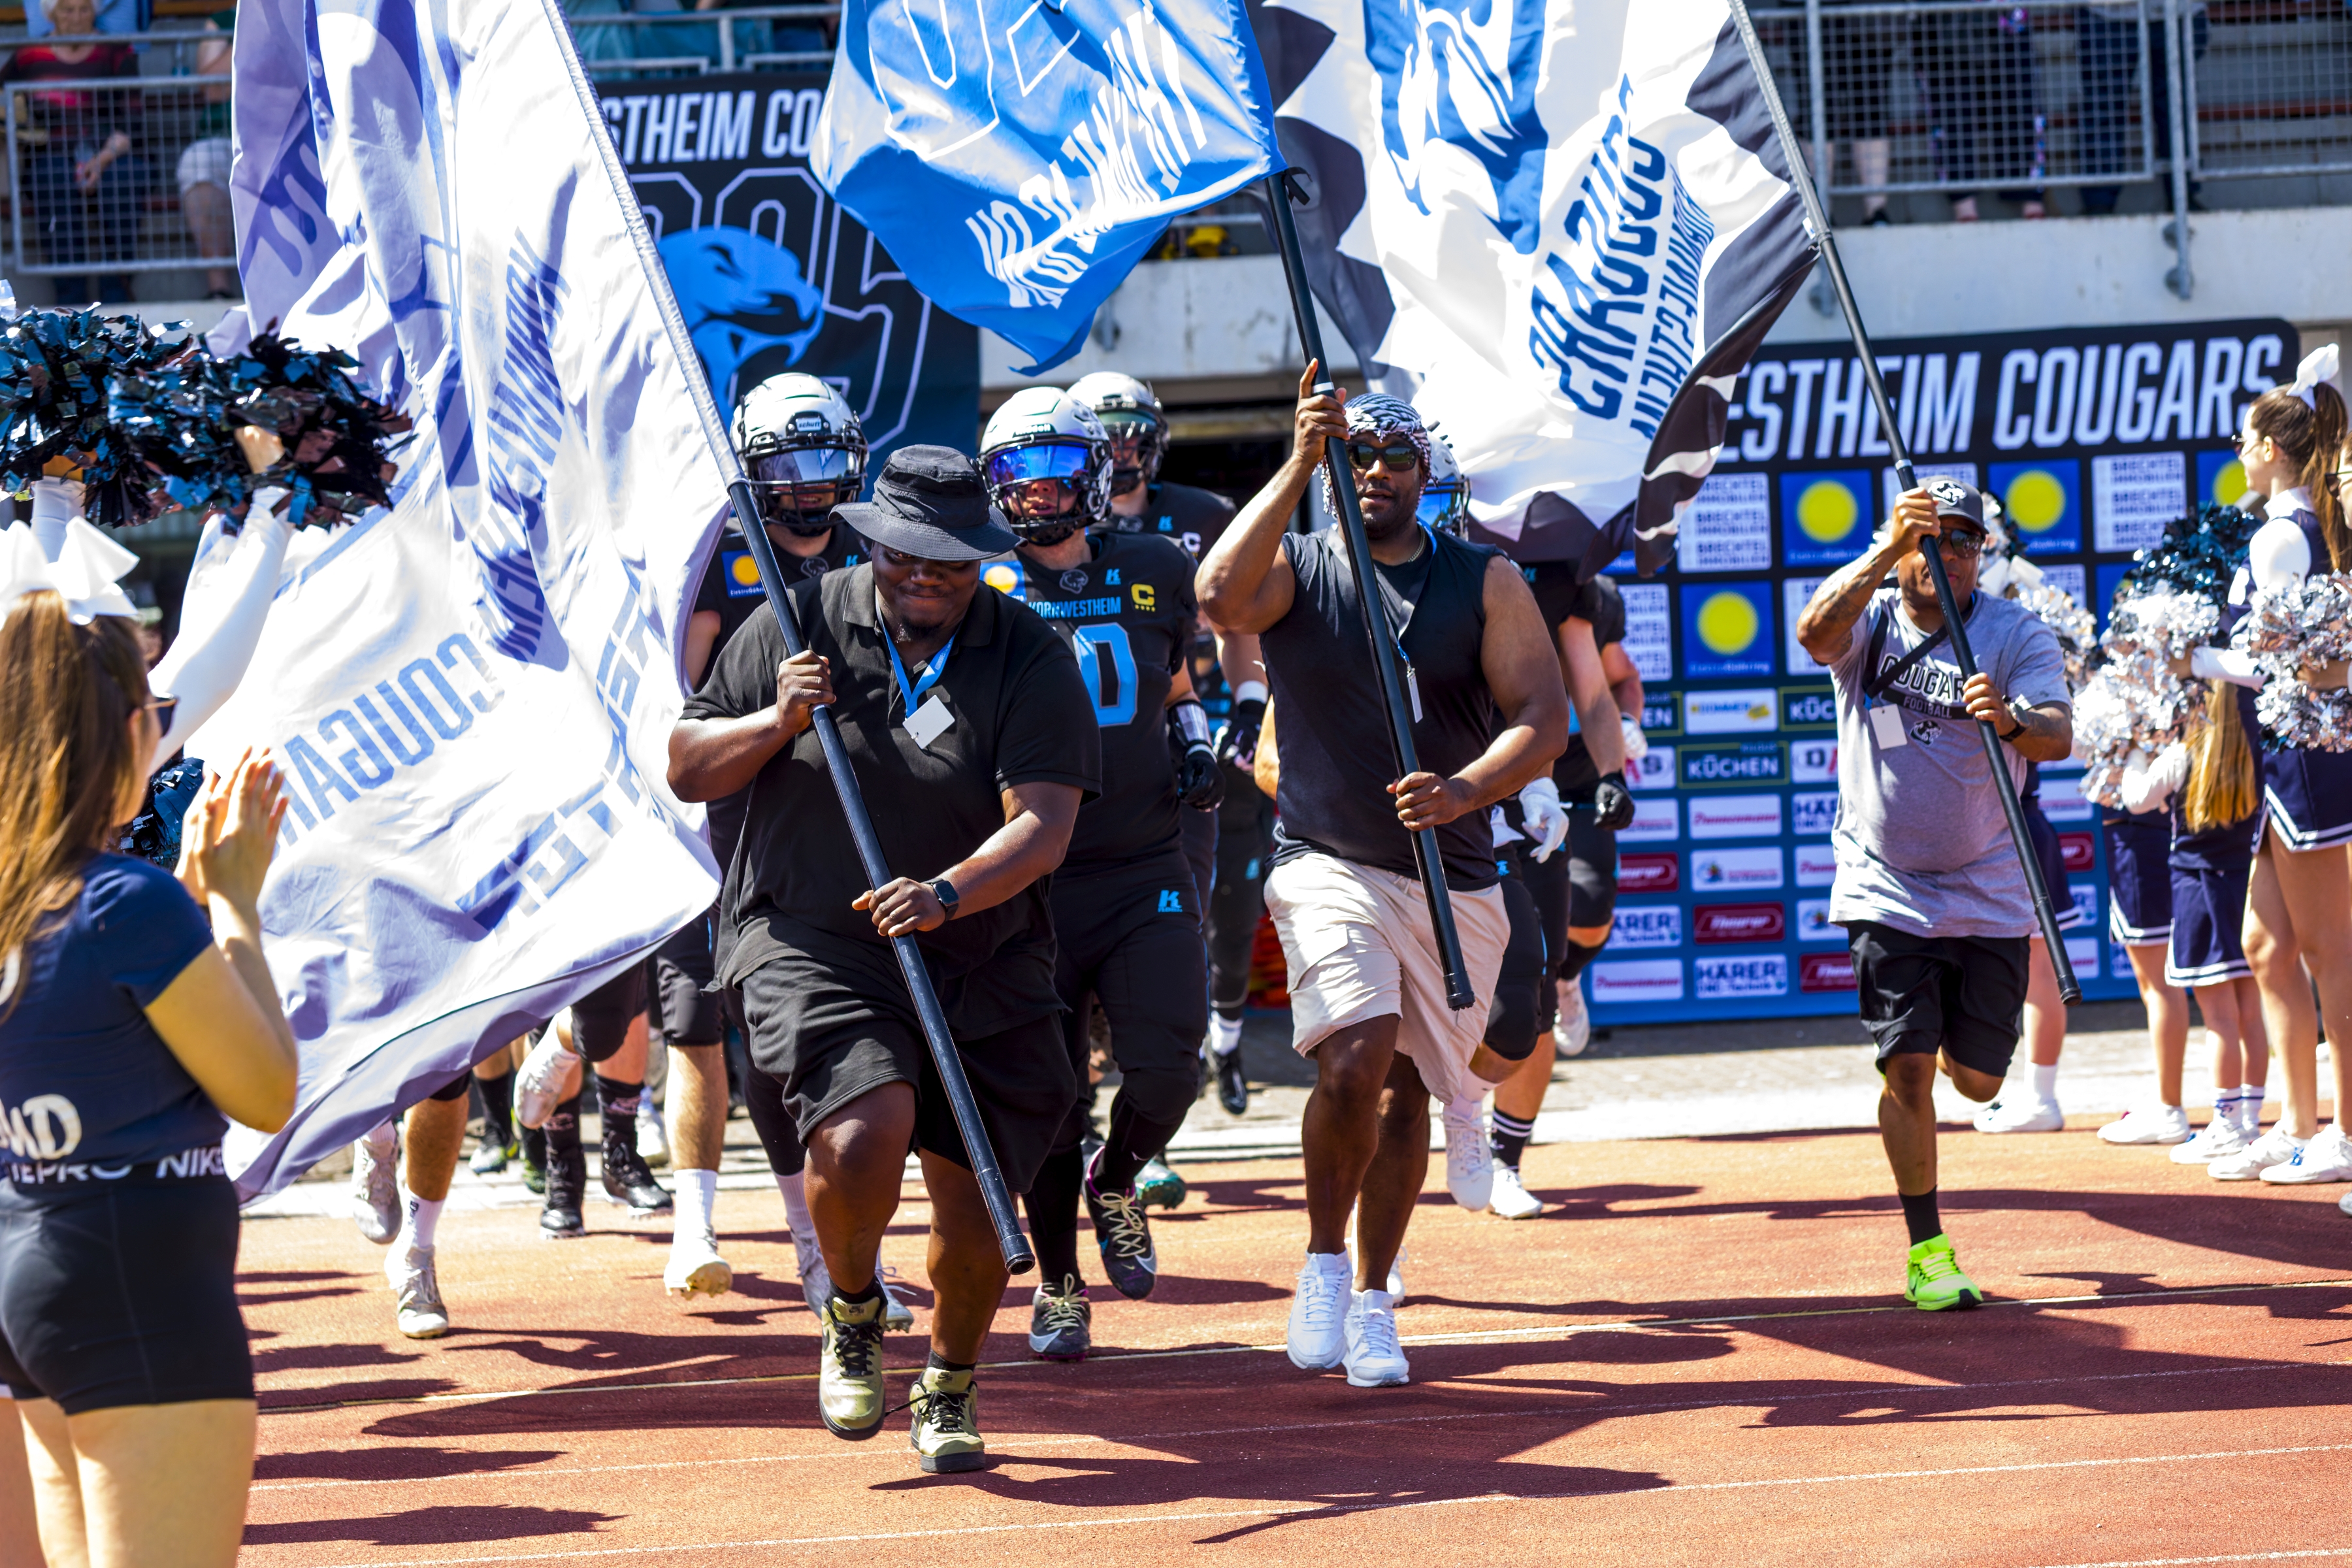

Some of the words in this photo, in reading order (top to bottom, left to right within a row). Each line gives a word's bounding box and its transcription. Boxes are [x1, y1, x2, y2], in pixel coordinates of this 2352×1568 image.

[1992, 334, 2283, 451] COUGARS
[1131, 583, 1155, 606] C
[1903, 695, 1953, 719] FOOTBALL
[1688, 753, 1779, 780] KÜCHEN
